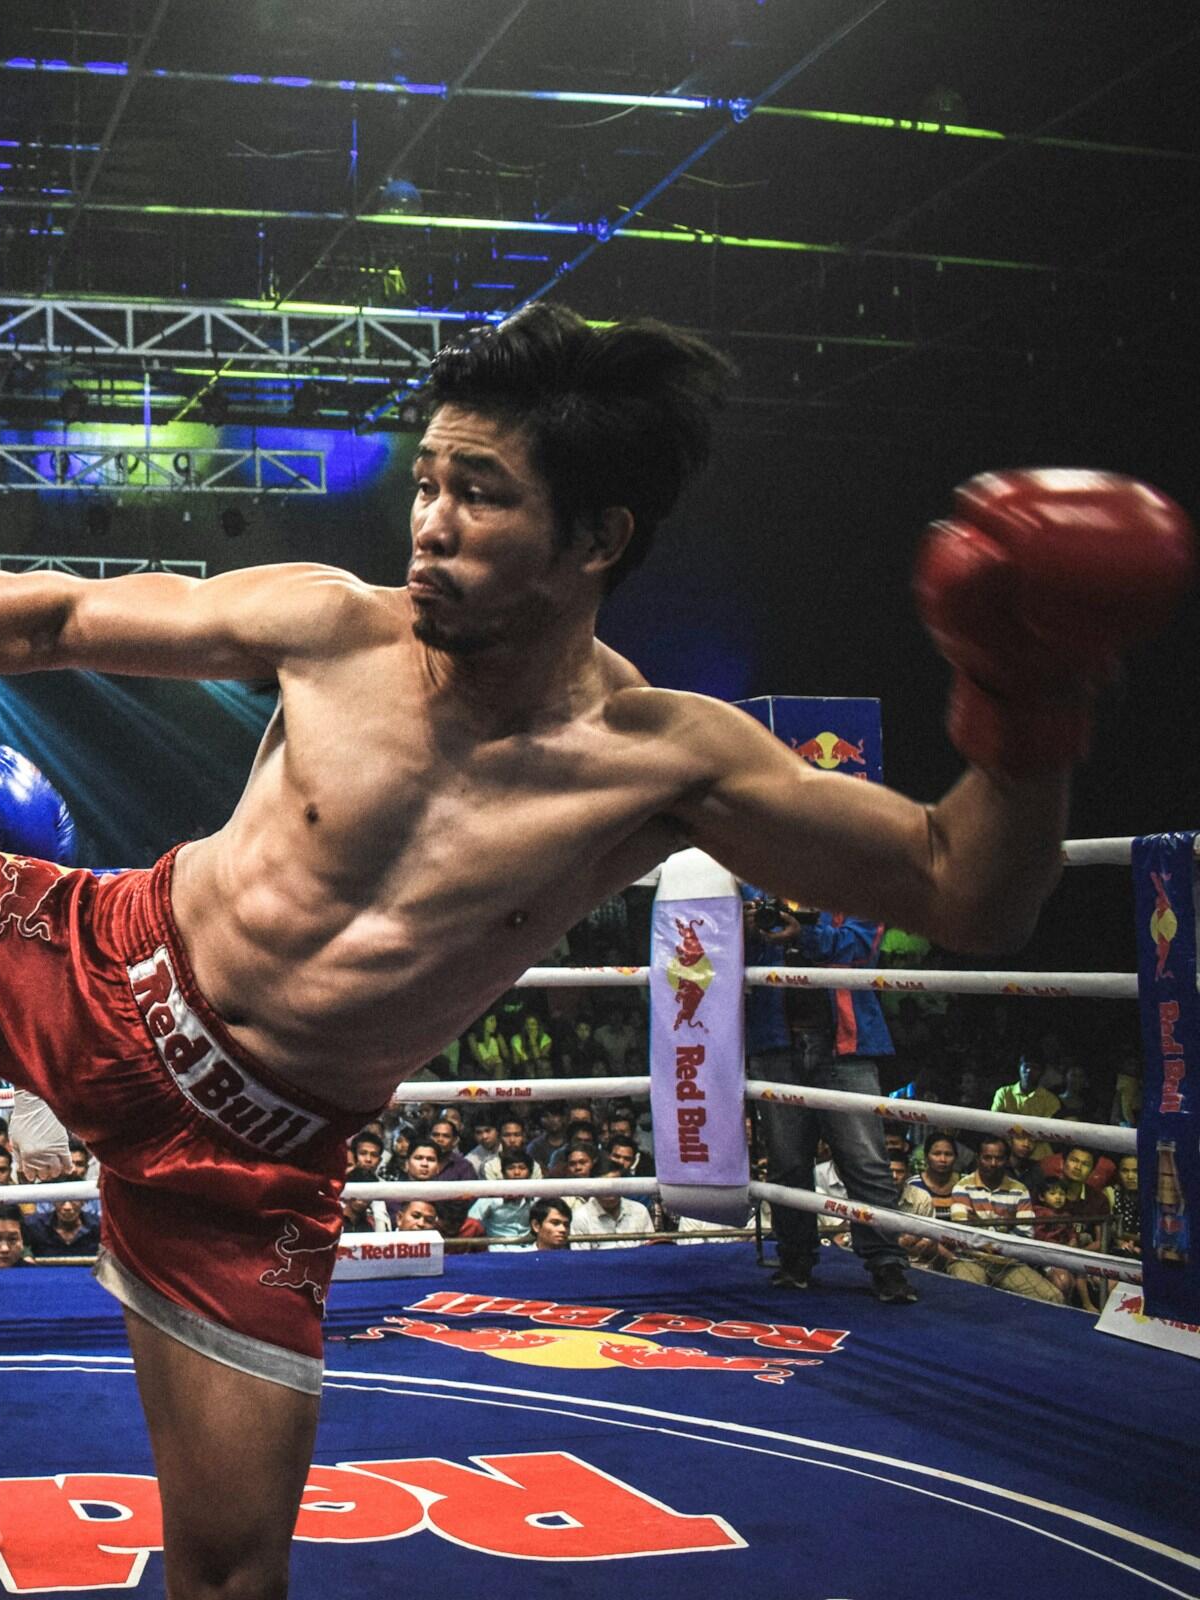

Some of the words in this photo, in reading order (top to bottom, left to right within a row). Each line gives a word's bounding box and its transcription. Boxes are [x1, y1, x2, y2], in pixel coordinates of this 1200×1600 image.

[1158, 1000, 1184, 1056] Red
[132, 961, 213, 1075] Red
[188, 1057, 312, 1155] Bull
[676, 1044, 706, 1102] Red
[1159, 1058, 1186, 1114] Bull
[495, 1087, 513, 1097] Red
[677, 1105, 709, 1163] Bull
[360, 1244, 395, 1260] Red
[396, 1242, 432, 1258] Bull
[403, 1291, 625, 1329] Bull
[619, 1312, 851, 1353] Red
